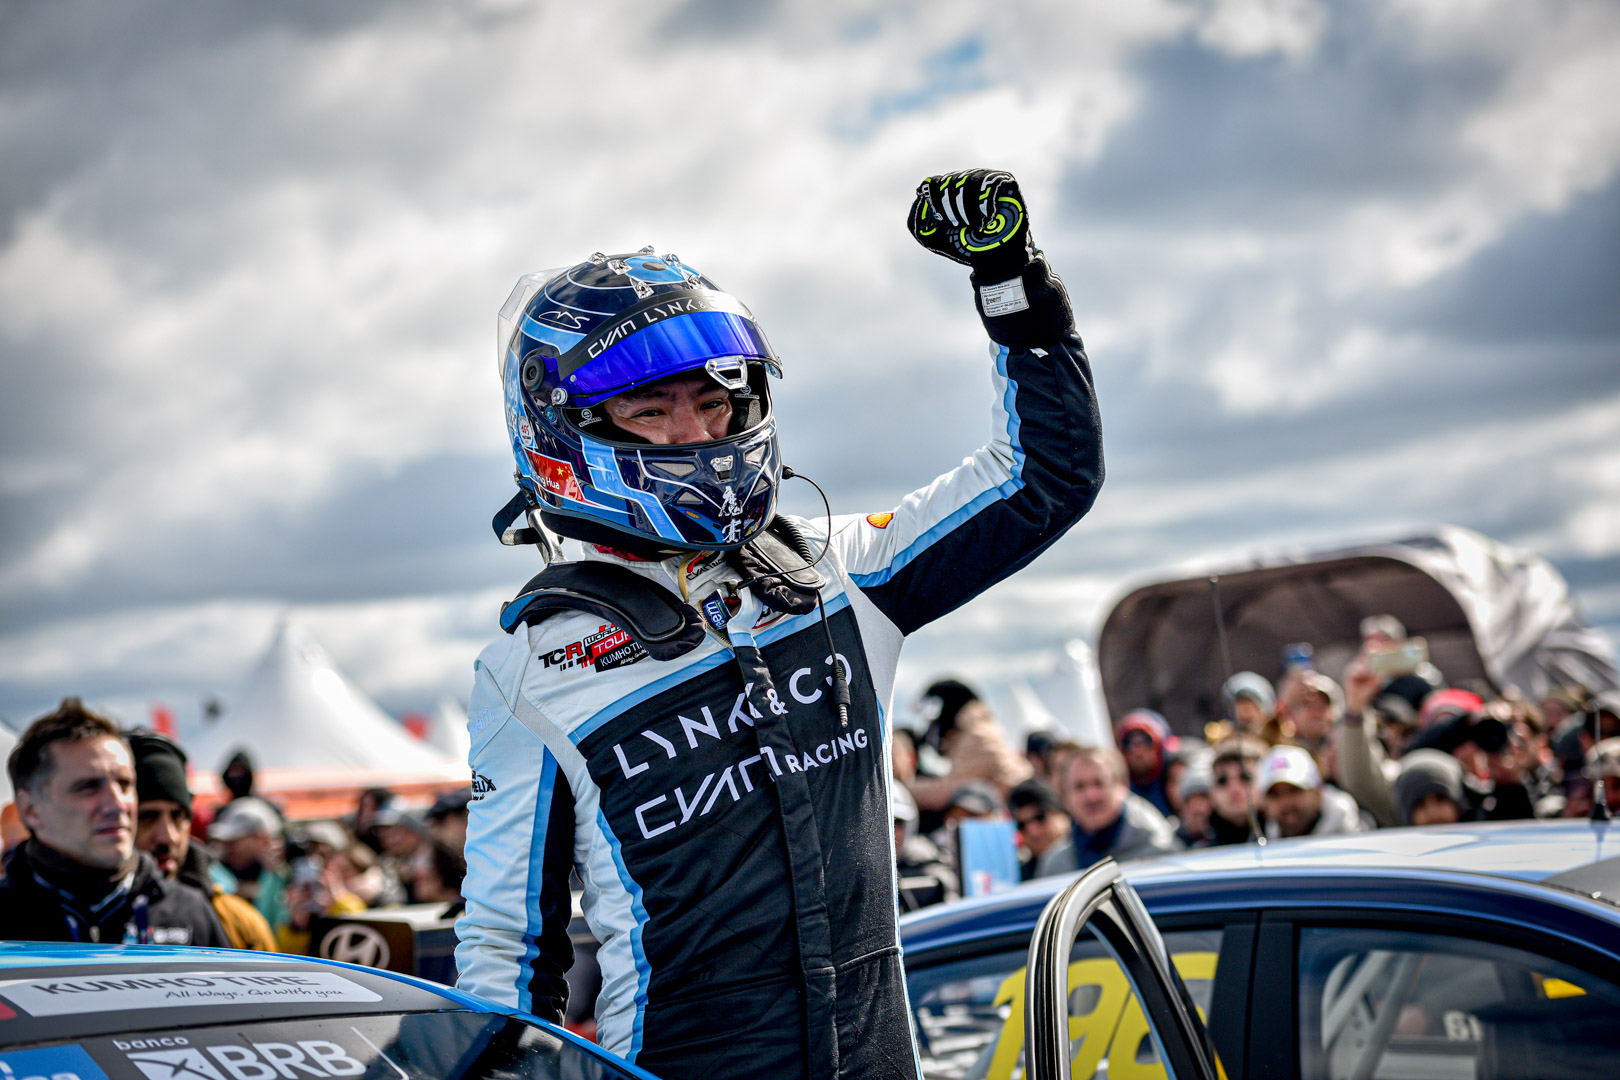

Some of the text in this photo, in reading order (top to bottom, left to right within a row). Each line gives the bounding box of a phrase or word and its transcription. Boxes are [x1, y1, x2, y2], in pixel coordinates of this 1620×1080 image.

[587, 319, 637, 359] CYAN
[538, 640, 584, 669] TCR
[600, 646, 632, 667] KUMHO
[612, 682, 764, 780] LYNK
[765, 687, 789, 716] &
[634, 728, 869, 840] CYAN RACING
[31, 976, 321, 995] KUMHO TIRE
[314, 990, 344, 998] you
[112, 1036, 190, 1051] banco
[205, 1040, 367, 1080] BRB
